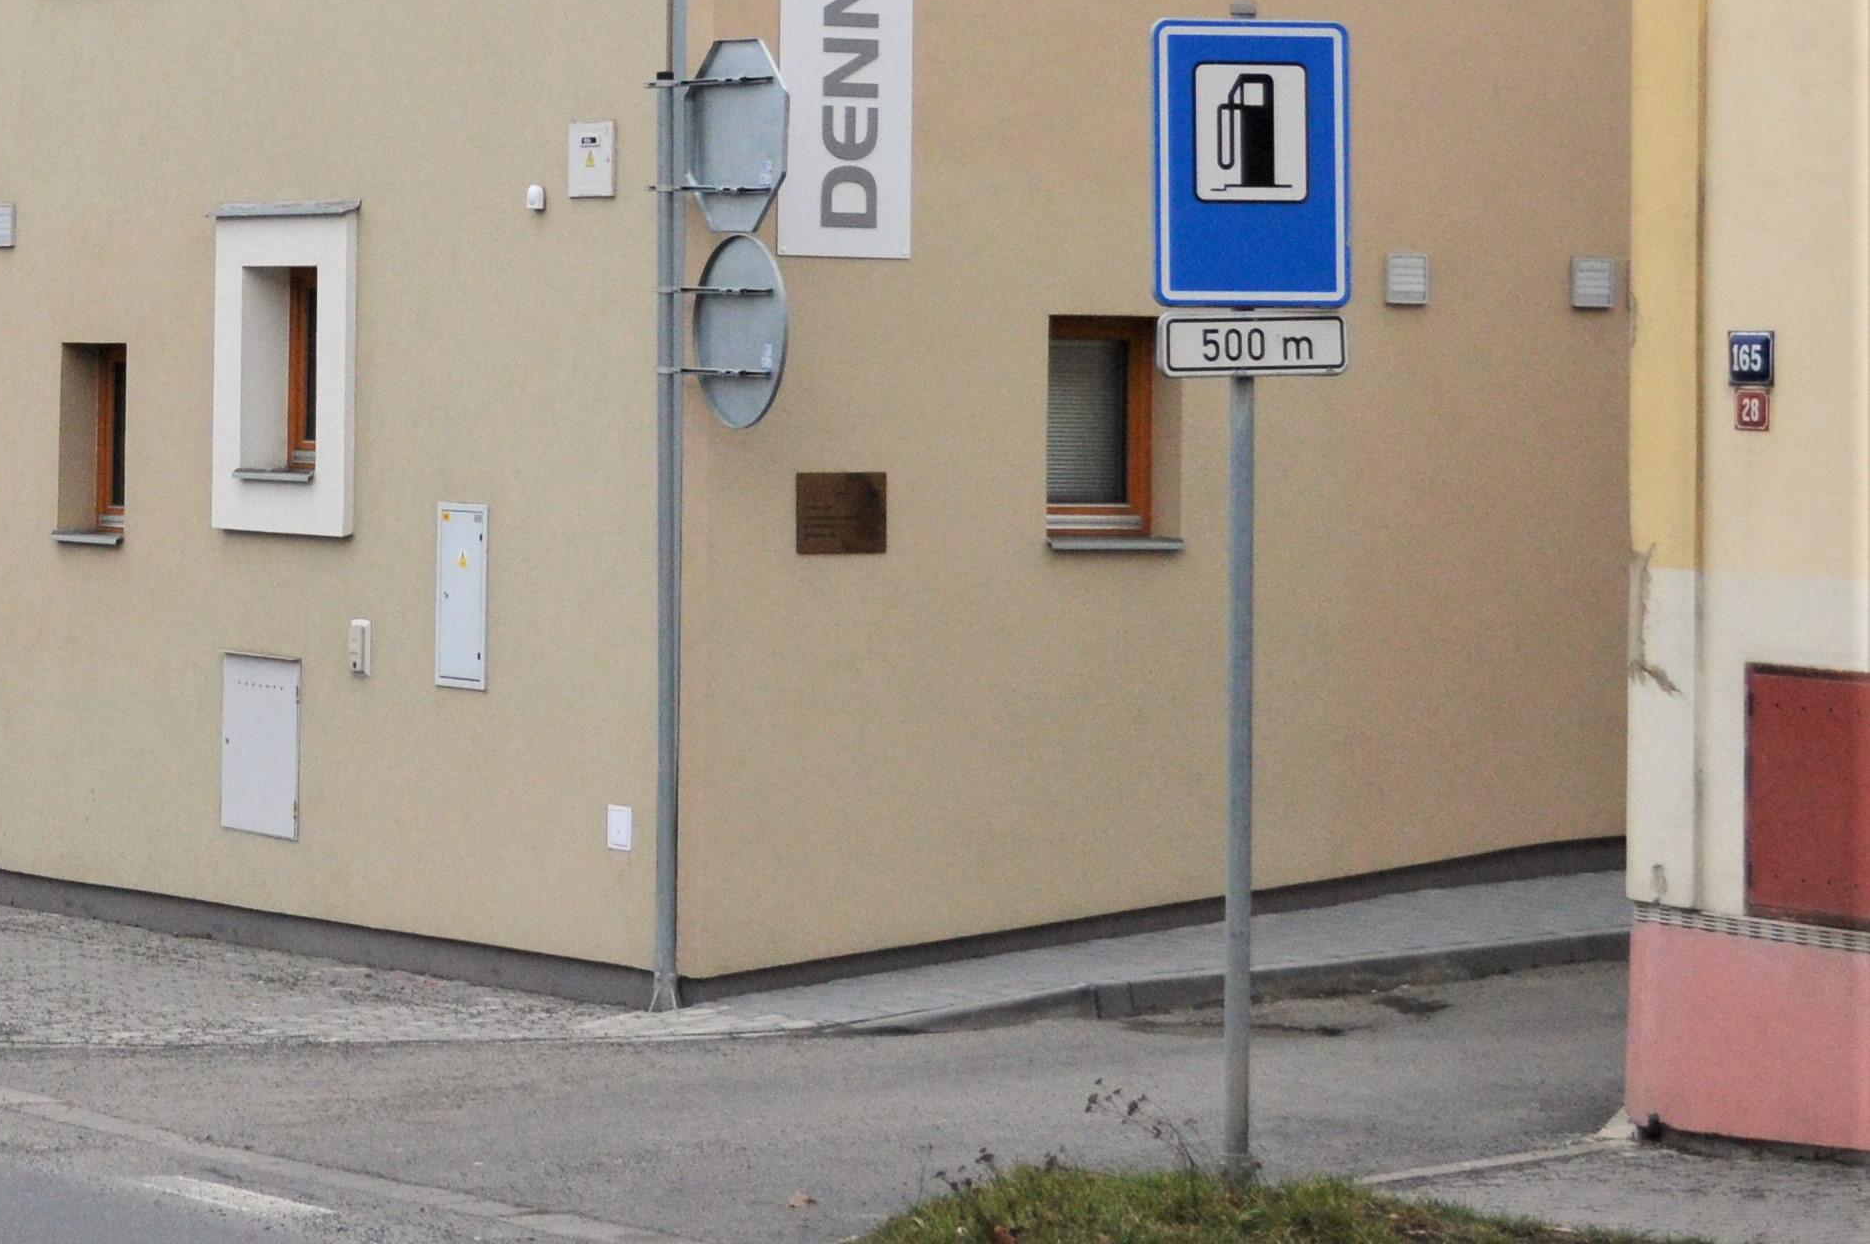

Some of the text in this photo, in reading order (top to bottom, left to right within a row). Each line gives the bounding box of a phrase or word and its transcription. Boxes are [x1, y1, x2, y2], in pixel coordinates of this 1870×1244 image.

[1202, 328, 1314, 362] 500 m
[1732, 344, 1762, 372] 165
[1741, 397, 1760, 422] 28
